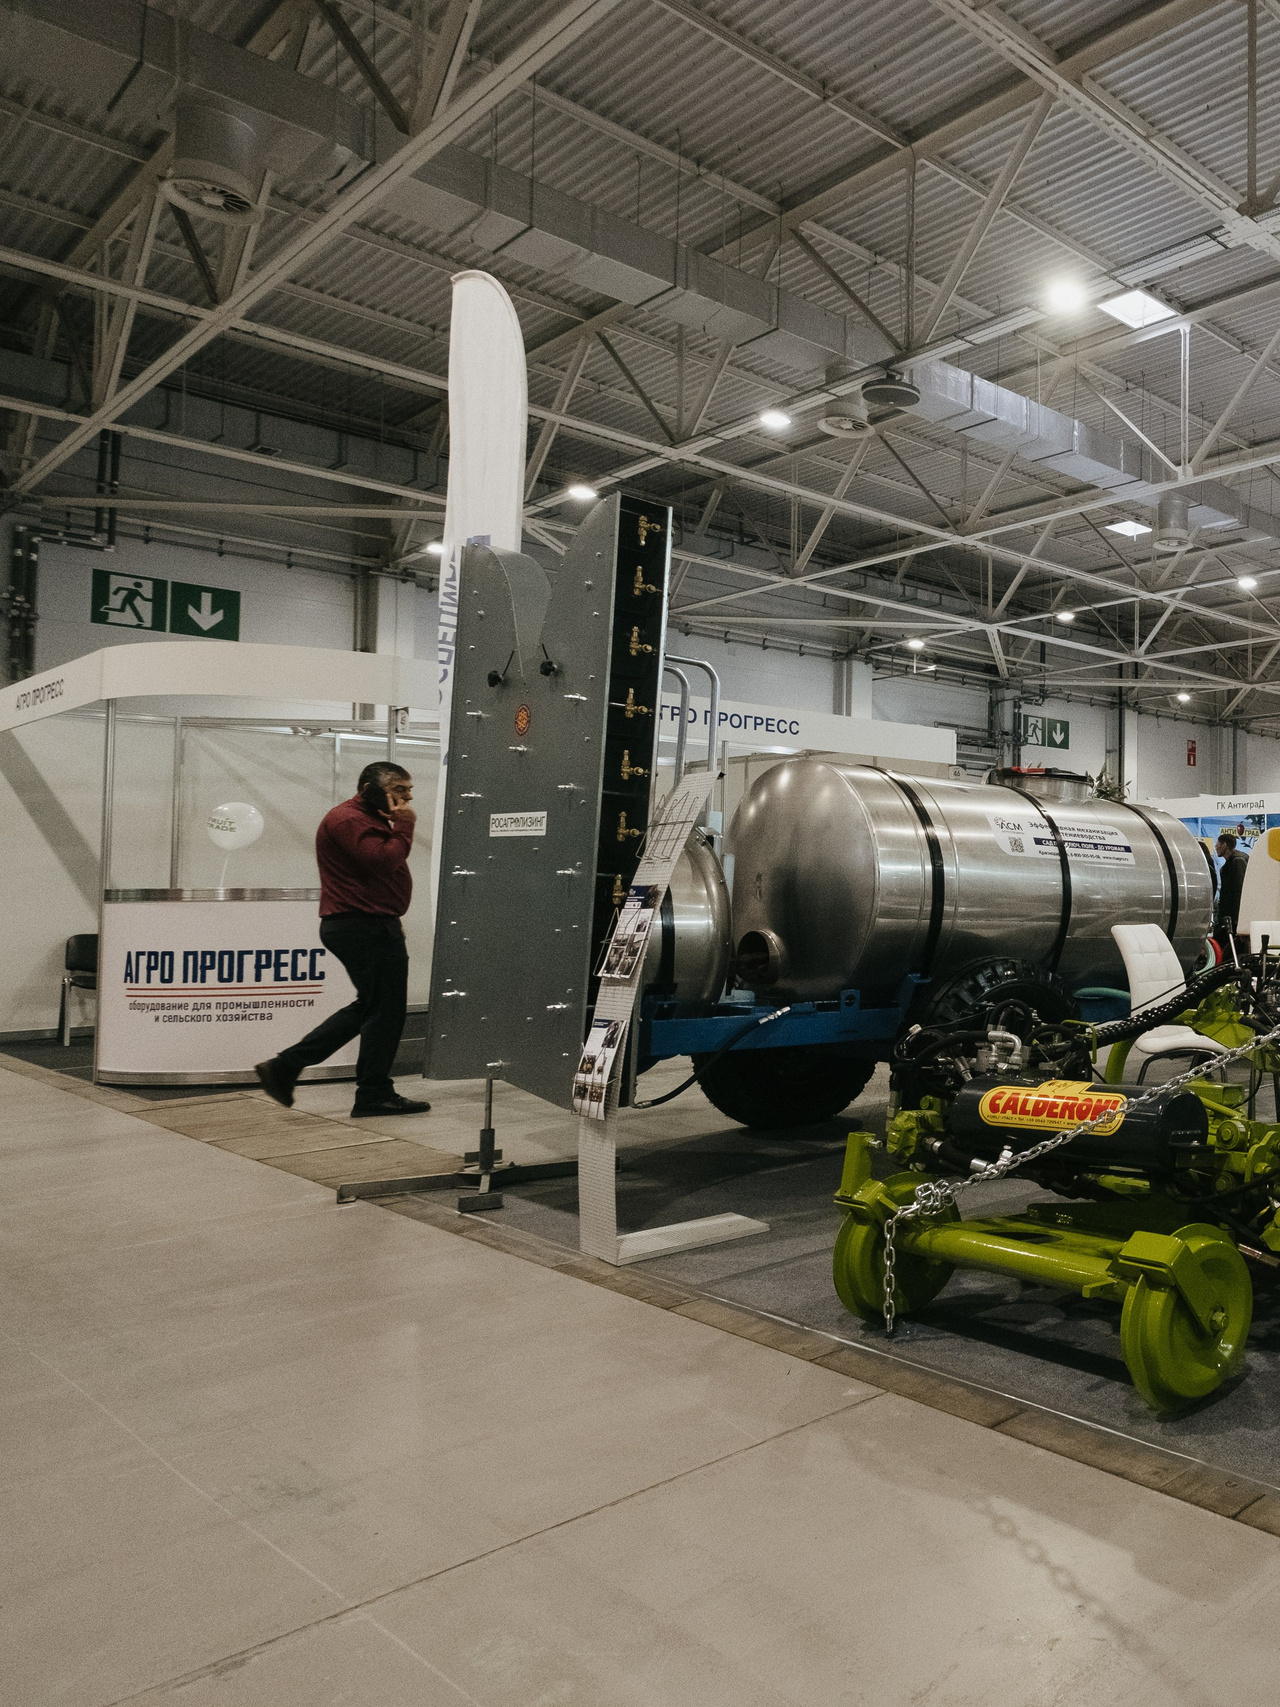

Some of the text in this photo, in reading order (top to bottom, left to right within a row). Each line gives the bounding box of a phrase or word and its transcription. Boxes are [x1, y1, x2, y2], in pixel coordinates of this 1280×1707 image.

[660, 704, 697, 724] ГРО
[123, 948, 326, 984] АГРО ПРОГРЕСС
[128, 999, 315, 1013] оборудование для промышленности
[162, 1013, 212, 1023] сельского
[215, 1011, 273, 1022] хозяйства
[989, 1091, 1120, 1122] CALDERONI
